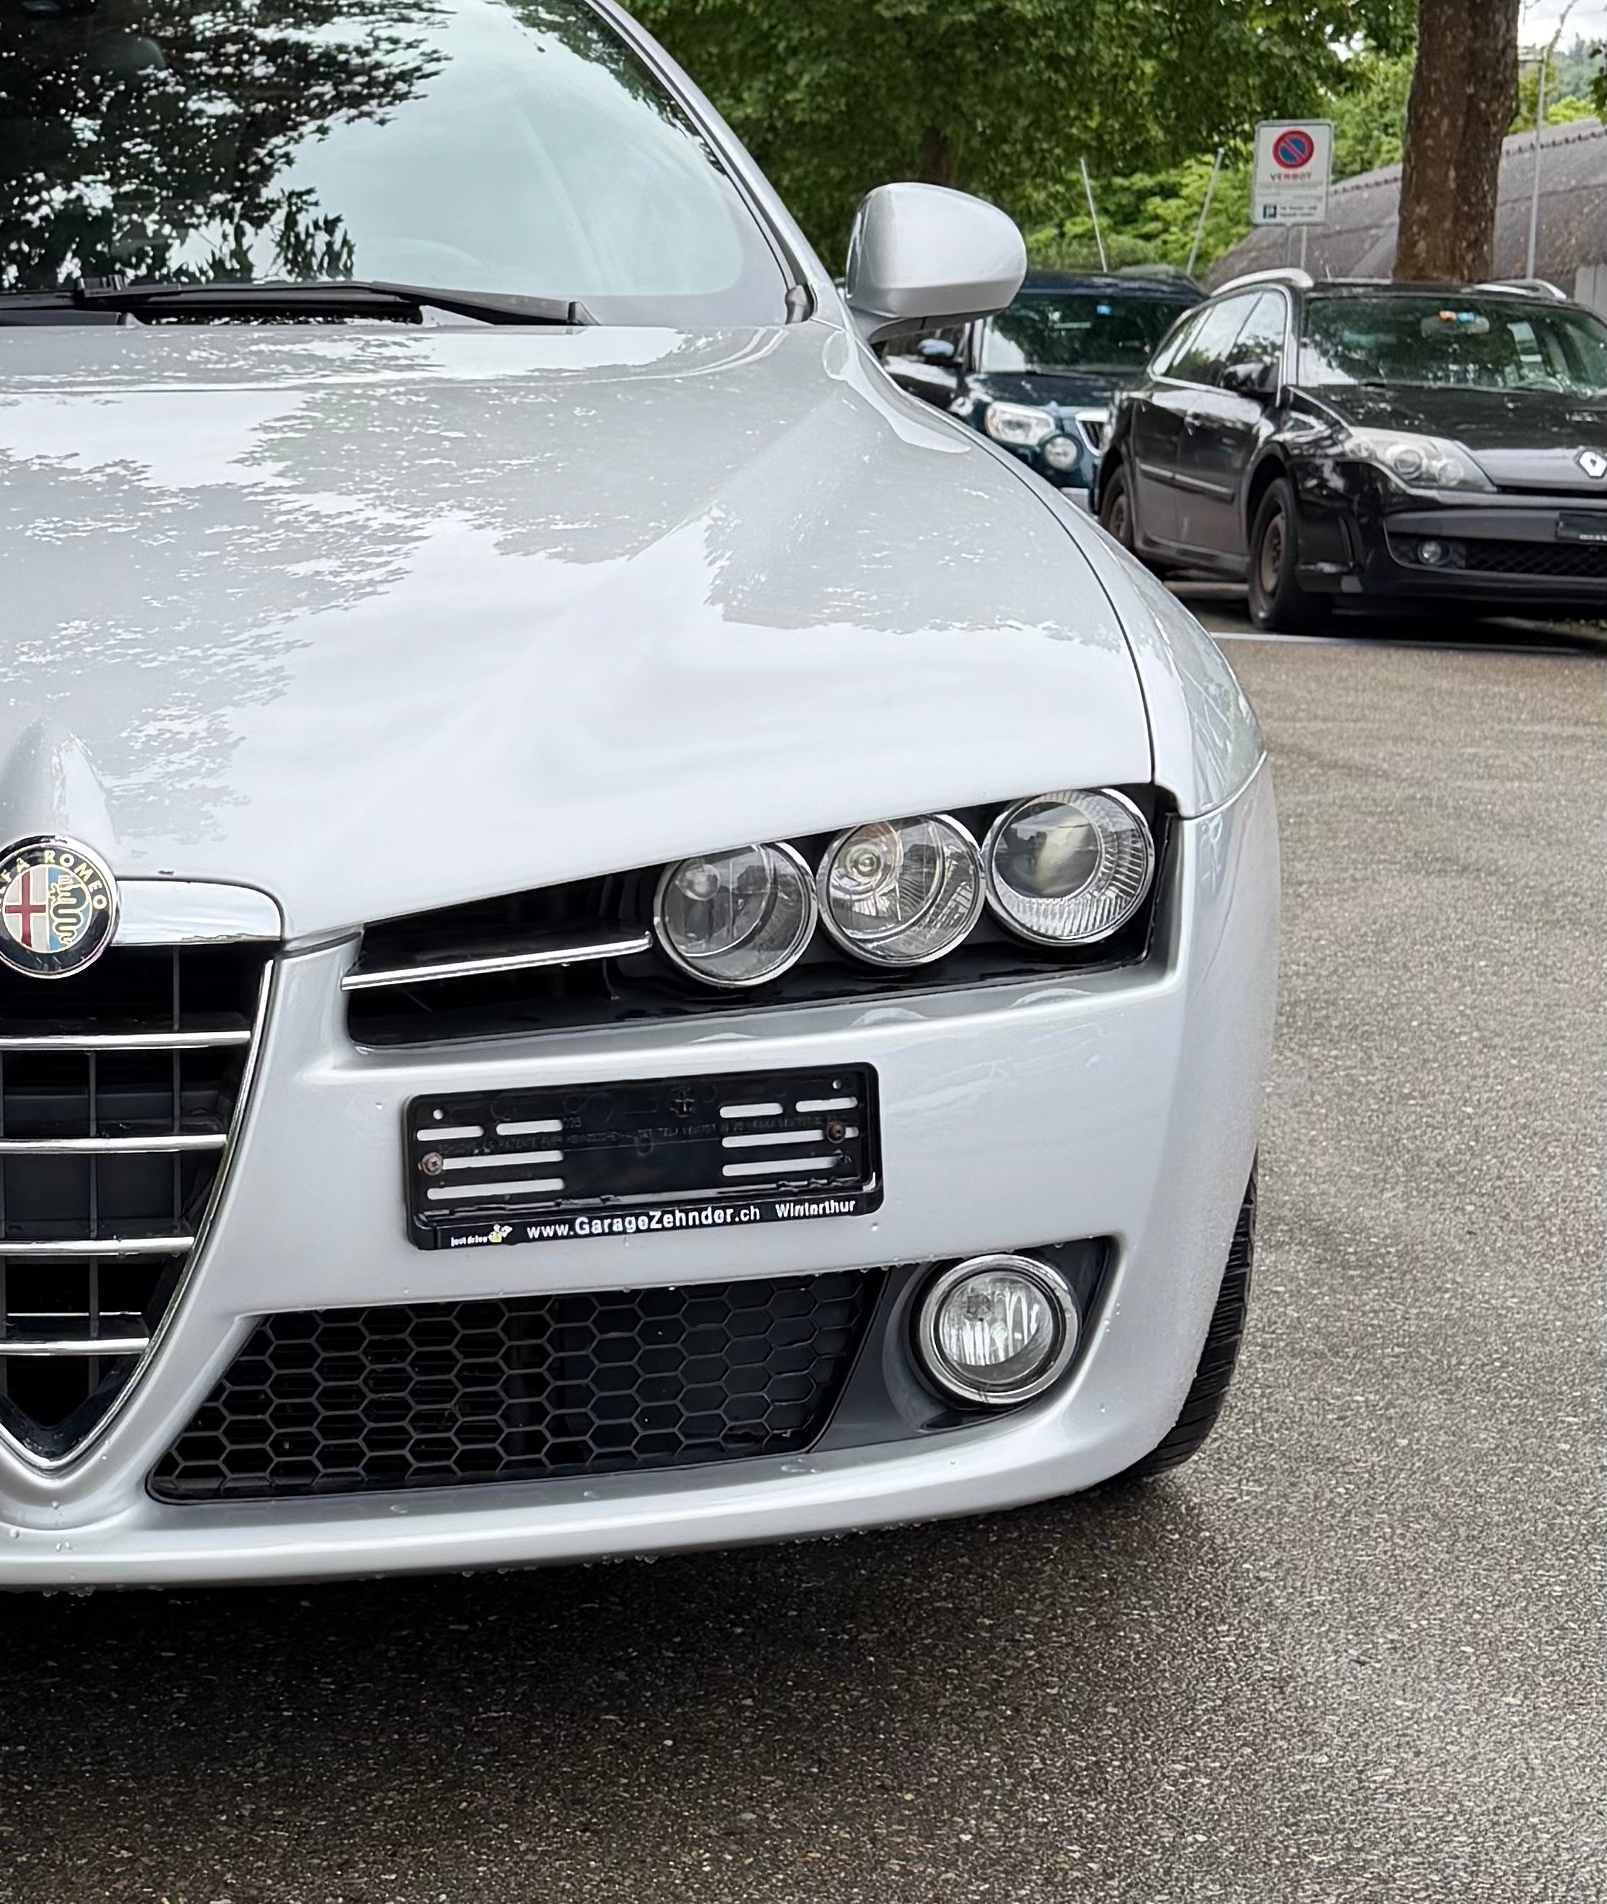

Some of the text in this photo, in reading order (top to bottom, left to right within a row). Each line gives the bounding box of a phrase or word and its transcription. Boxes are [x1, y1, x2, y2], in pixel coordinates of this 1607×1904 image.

[44, 849, 107, 910] ROMEO
[526, 1199, 856, 1239] www.GarageZehnder.ch Winterthur
